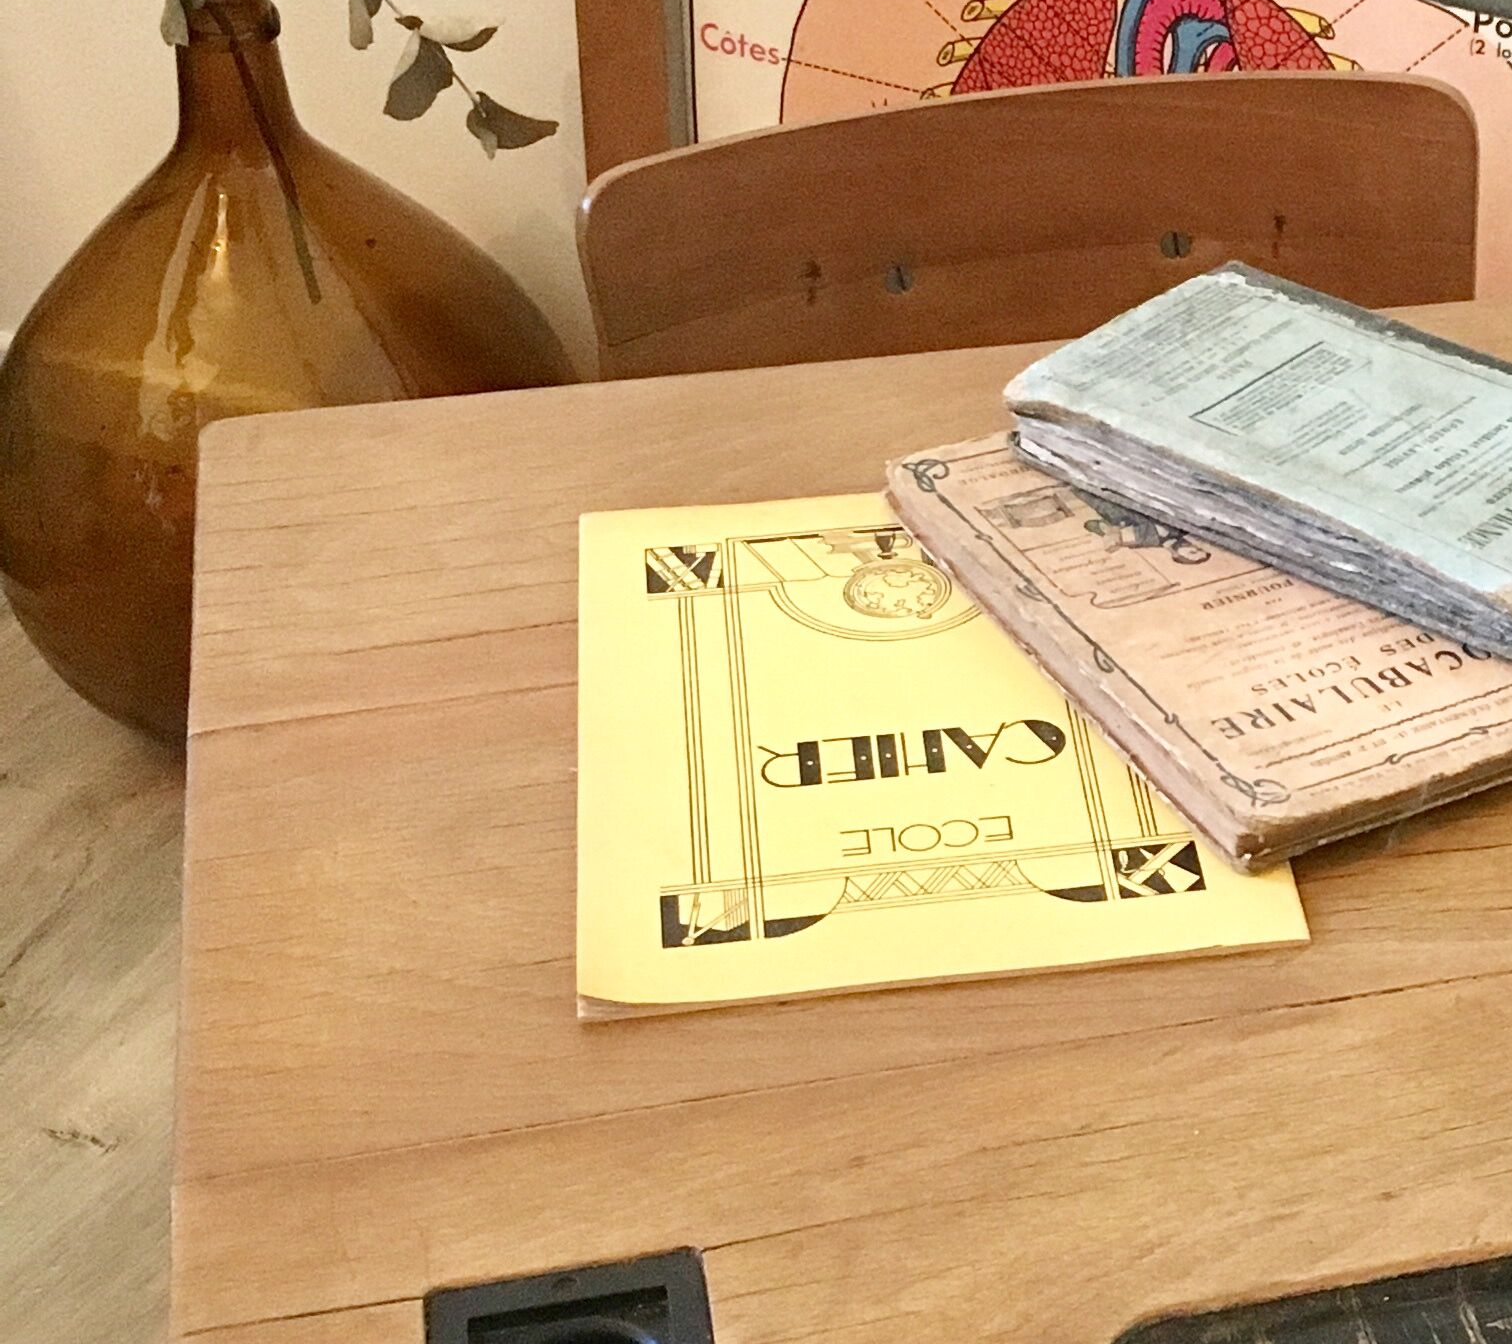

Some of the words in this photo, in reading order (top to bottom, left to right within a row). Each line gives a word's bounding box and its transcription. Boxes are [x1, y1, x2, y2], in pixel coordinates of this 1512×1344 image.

[700, 23, 780, 66] Côtes
[1469, 38, 1486, 56] (2
[1199, 577, 1293, 611] FOURNIER
[1377, 631, 1435, 657] DES
[1207, 642, 1492, 741] OCABULAIRE
[1248, 654, 1361, 696] ÉCOLES
[759, 719, 1067, 789] CAHIER
[841, 814, 1015, 857] ECOLE
